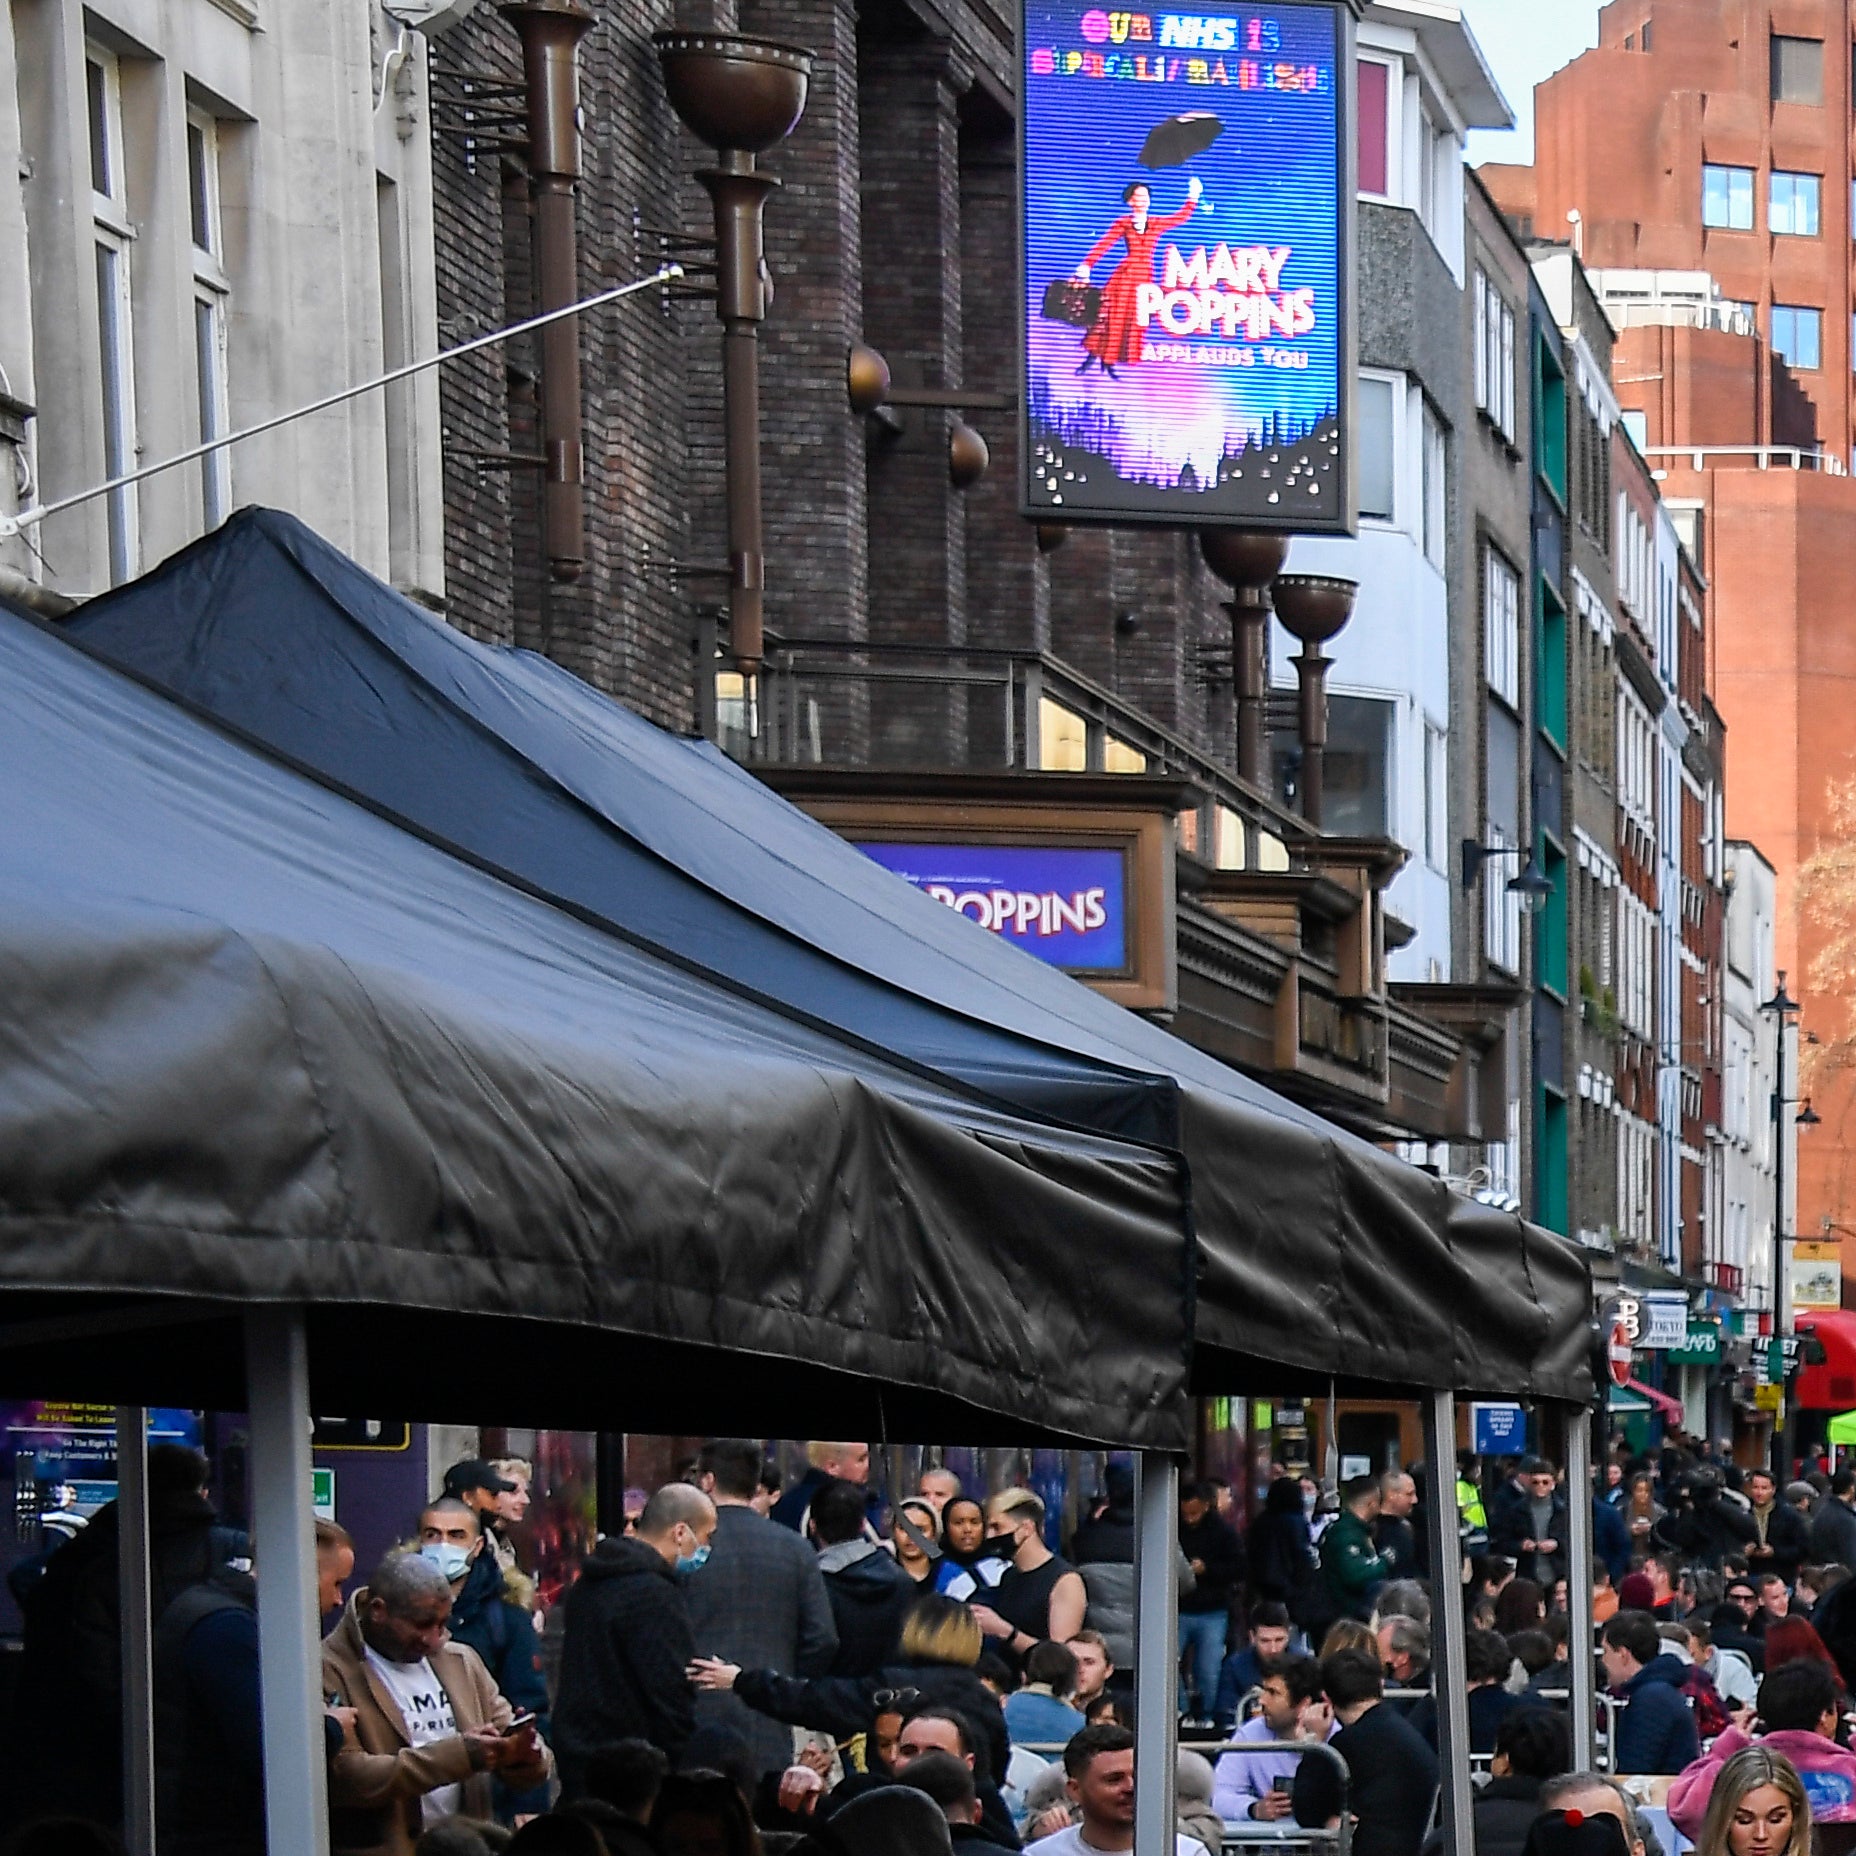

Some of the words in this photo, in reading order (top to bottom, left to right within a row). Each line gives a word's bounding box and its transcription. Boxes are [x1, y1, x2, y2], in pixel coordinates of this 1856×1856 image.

[1158, 15, 1238, 49] NHS
[1163, 242, 1292, 293] MARY
[1135, 283, 1316, 341] POPPINS
[1140, 343, 1255, 368] APPLAUDS
[1260, 346, 1309, 369] YOU
[413, 1717, 456, 1731] PRIS
